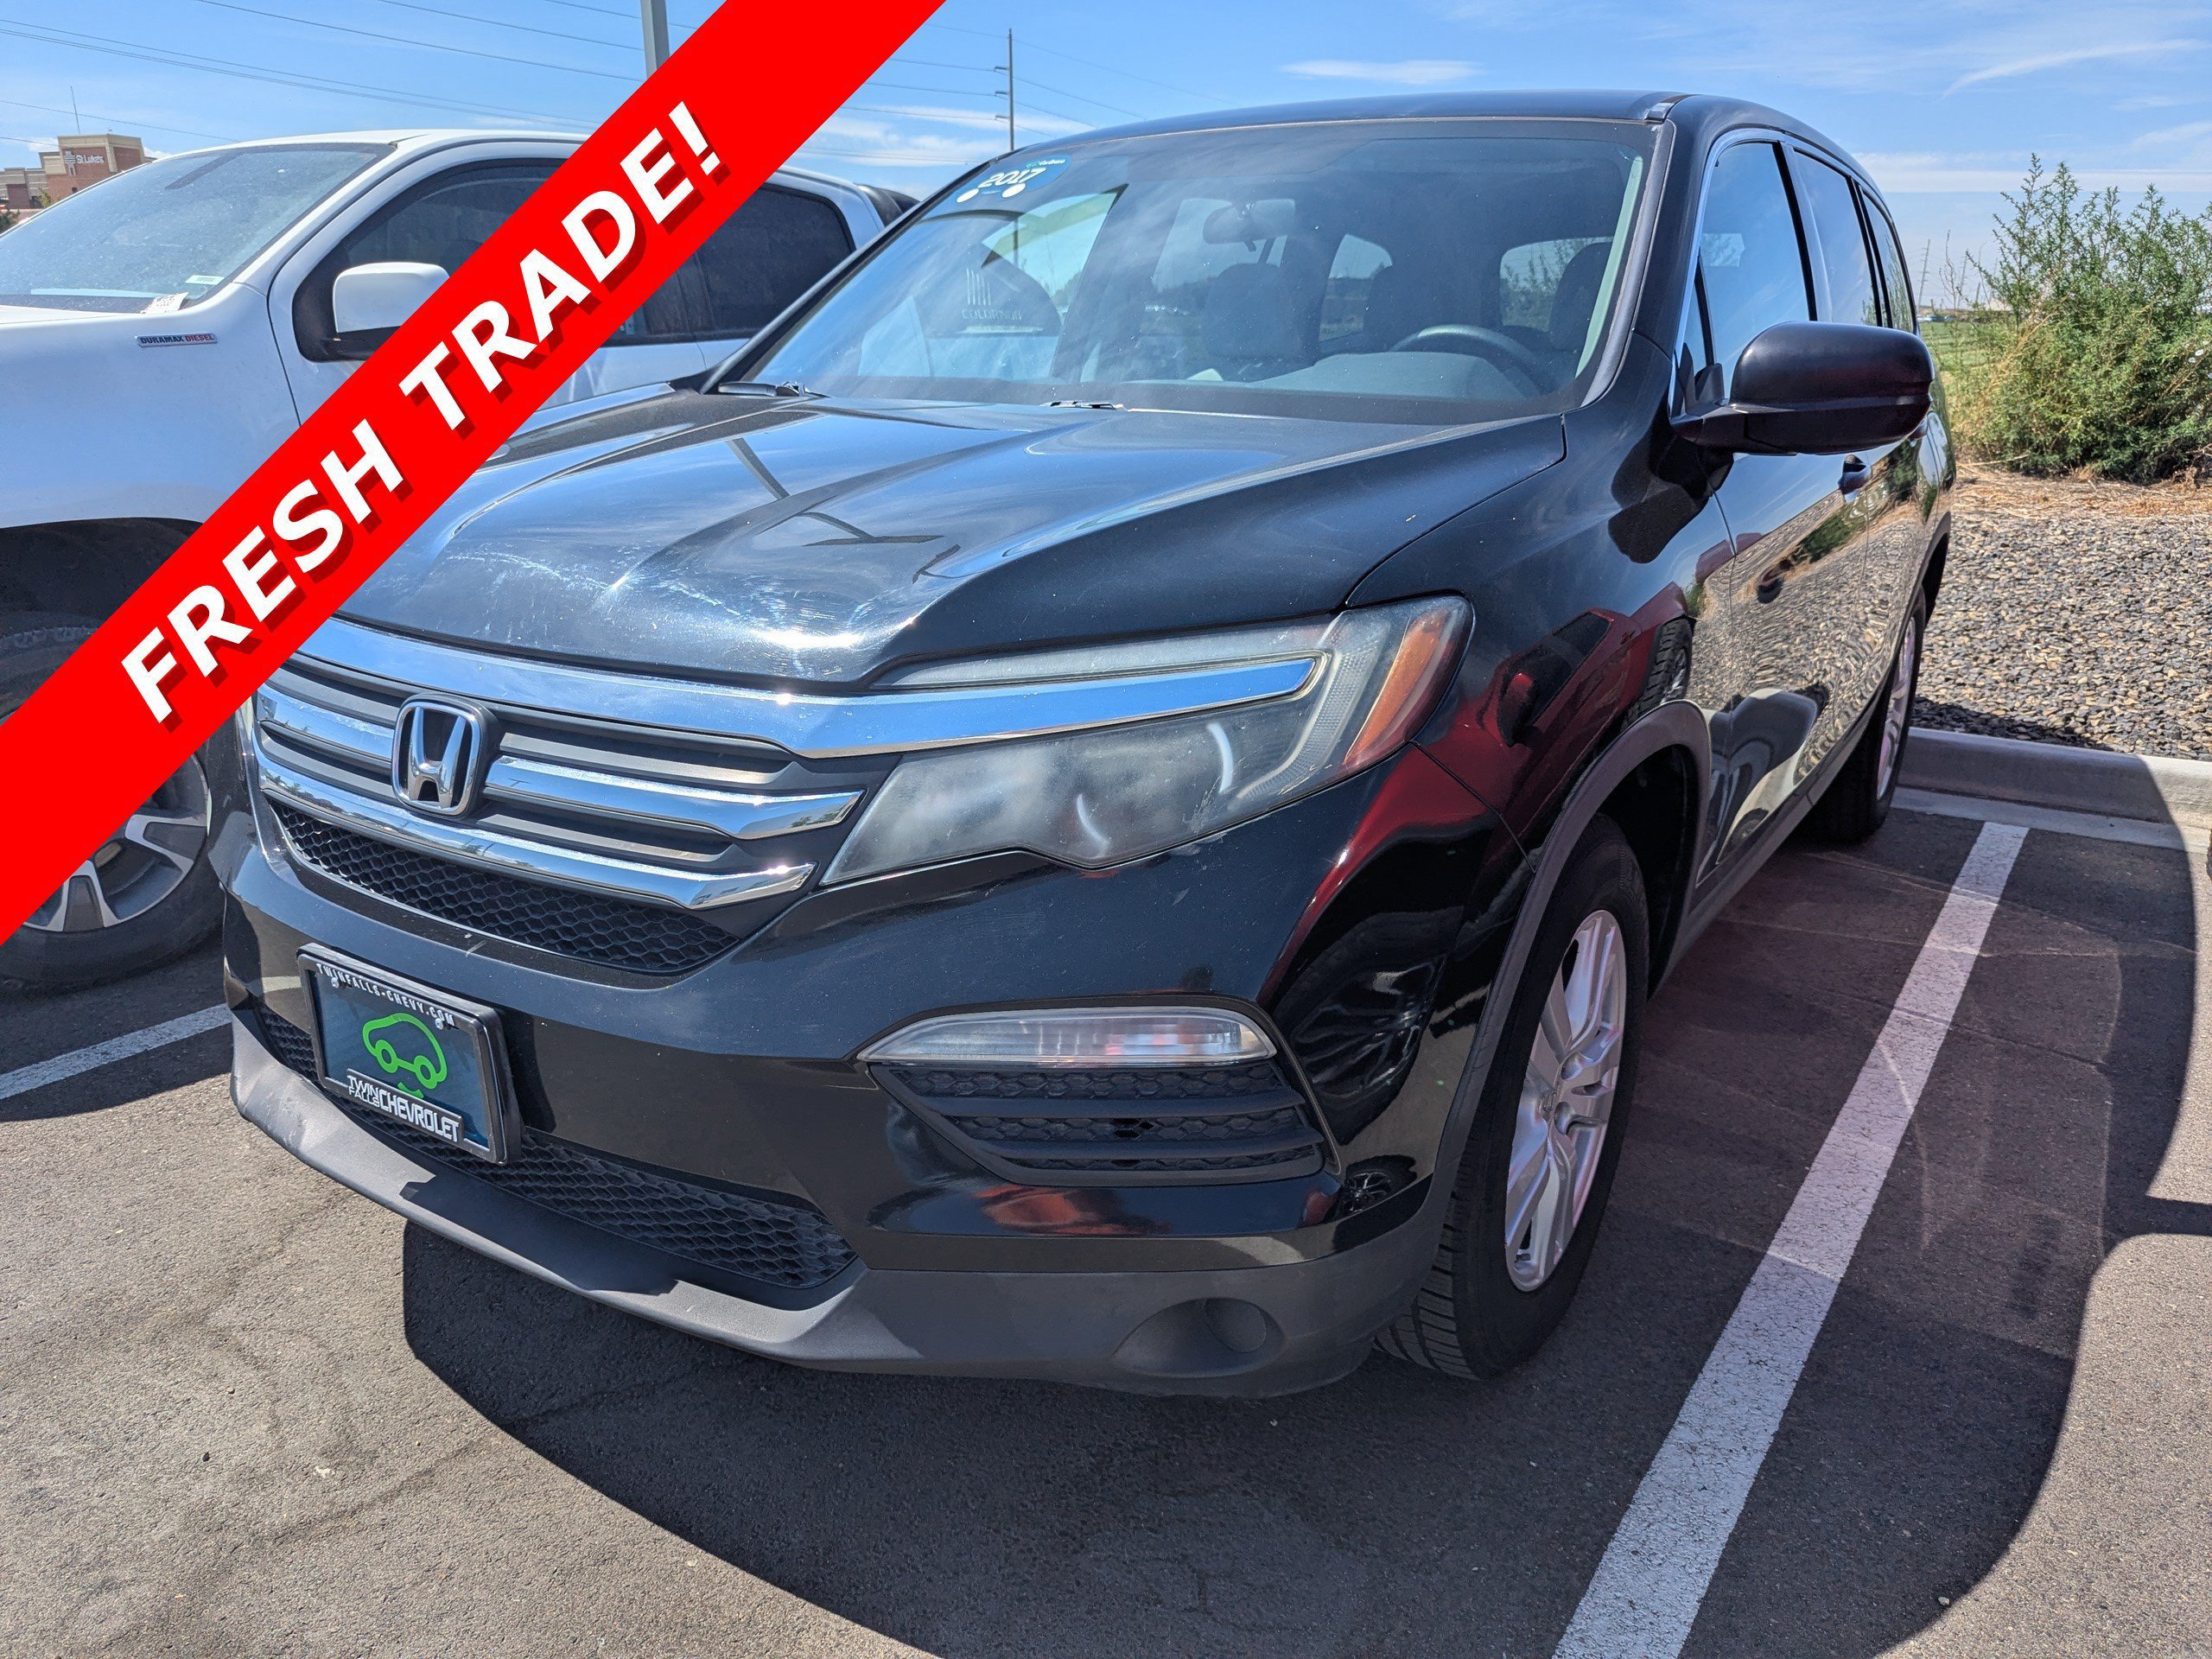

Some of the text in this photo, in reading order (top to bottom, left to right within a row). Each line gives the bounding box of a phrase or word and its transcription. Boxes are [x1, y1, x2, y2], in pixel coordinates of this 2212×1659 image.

[977, 167, 1046, 189] 2017
[140, 333, 215, 344] DURAMAX DIESEL
[346, 1075, 379, 1097] TWIN
[348, 1085, 380, 1108] FALLS
[378, 1090, 460, 1143] CHEVROLET
